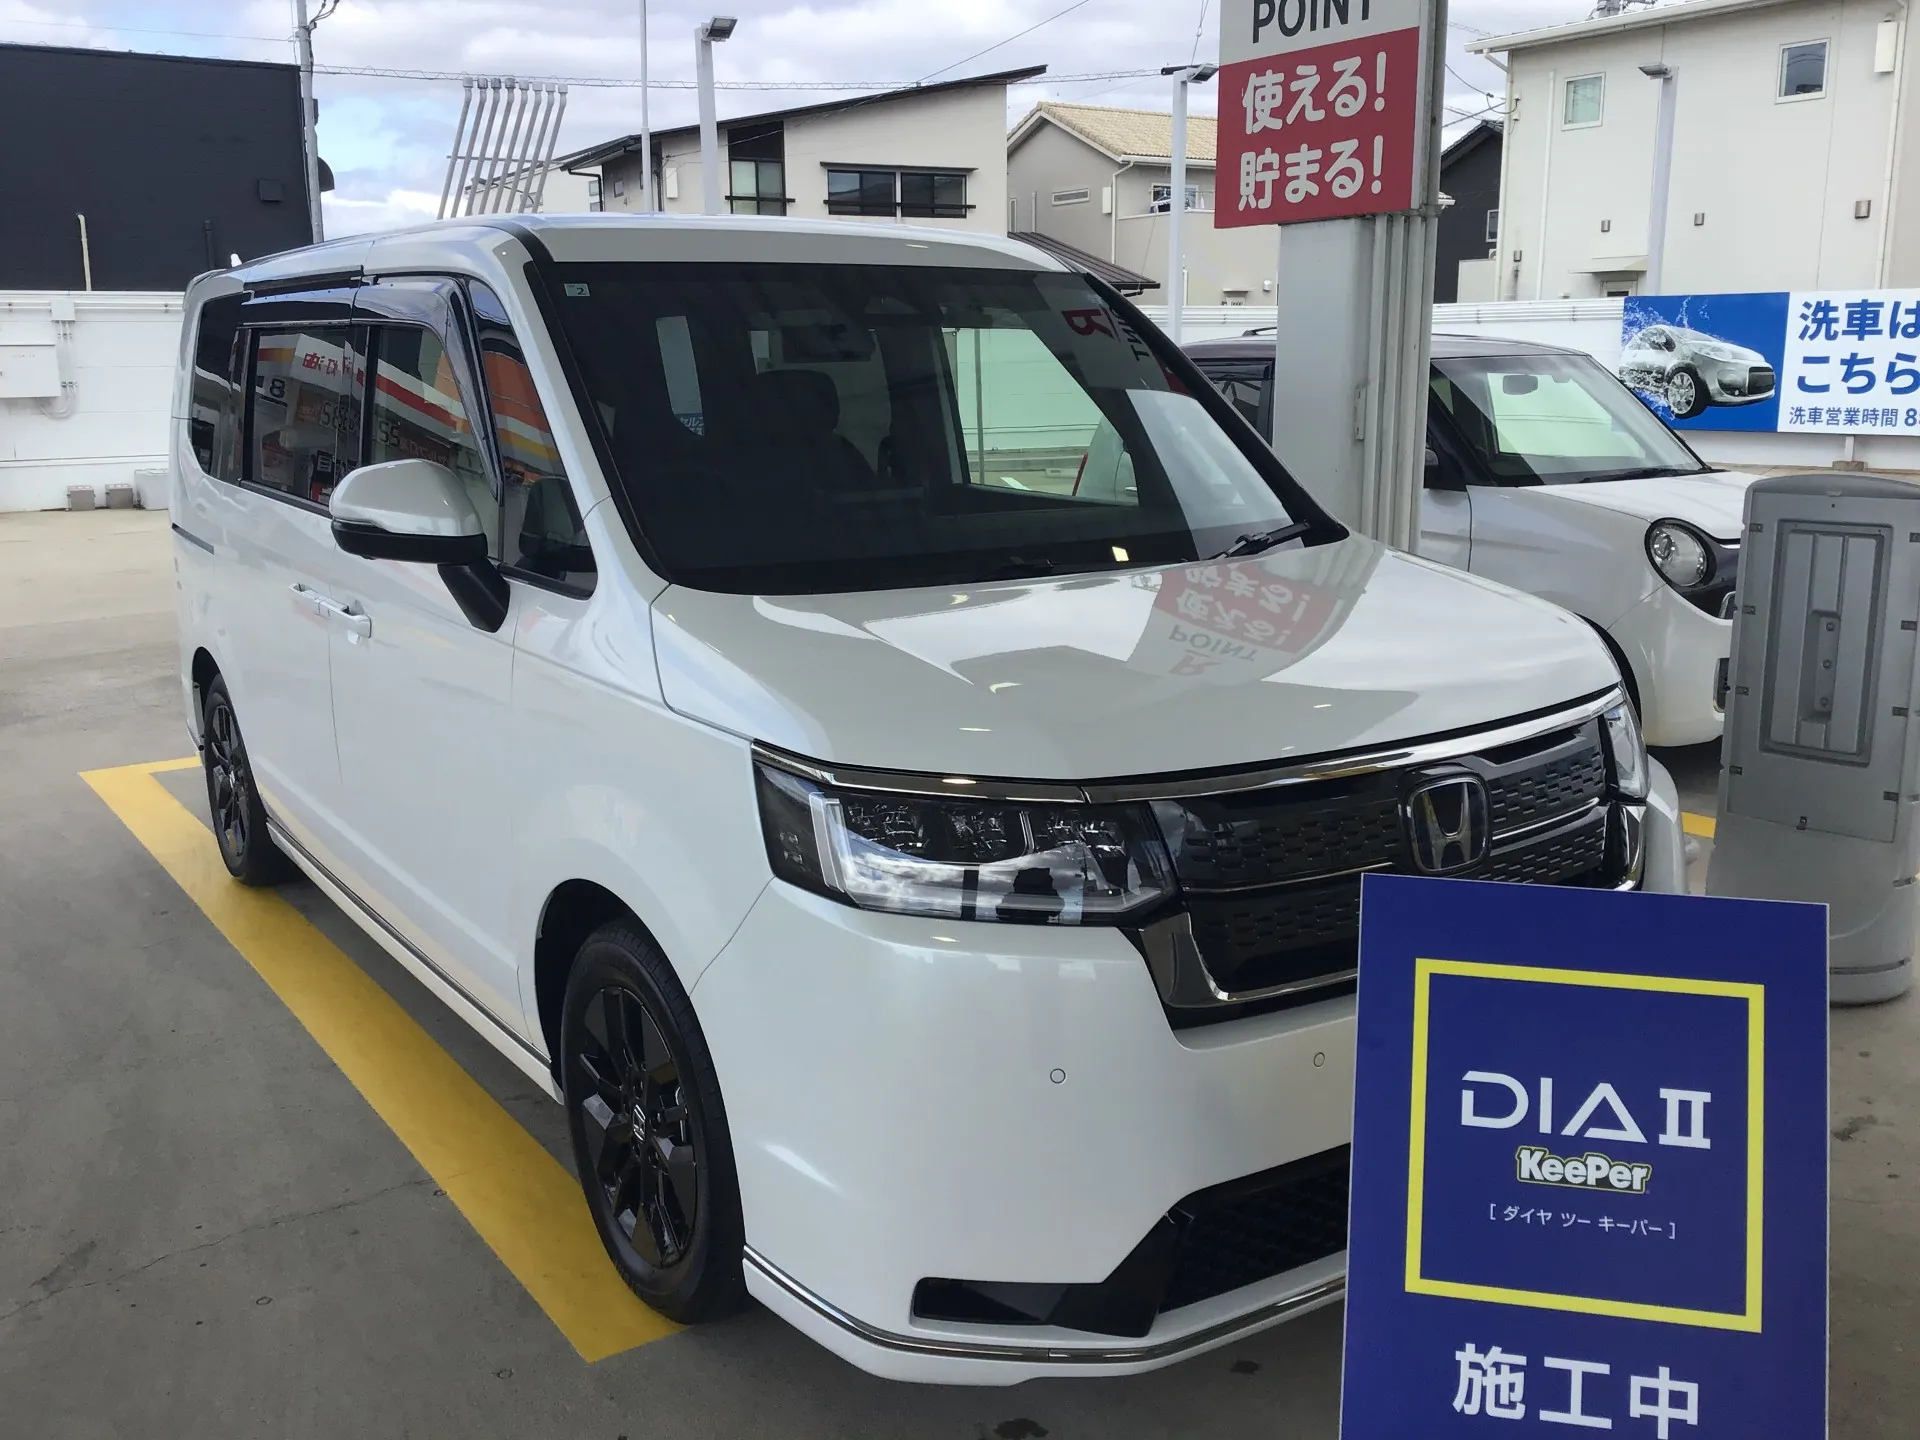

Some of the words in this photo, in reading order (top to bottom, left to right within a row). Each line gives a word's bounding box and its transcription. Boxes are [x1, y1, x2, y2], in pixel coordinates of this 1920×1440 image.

[1242, 51, 1387, 135] 使える!
[1238, 135, 1384, 212] 貯まる!
[1798, 299, 1920, 341] 洗車は
[1797, 352, 1920, 395] こちら
[1789, 406, 1899, 428] 洗車営業時間
[1518, 1147, 1650, 1191] KeePer
[1452, 1342, 1699, 1440] 施工中
